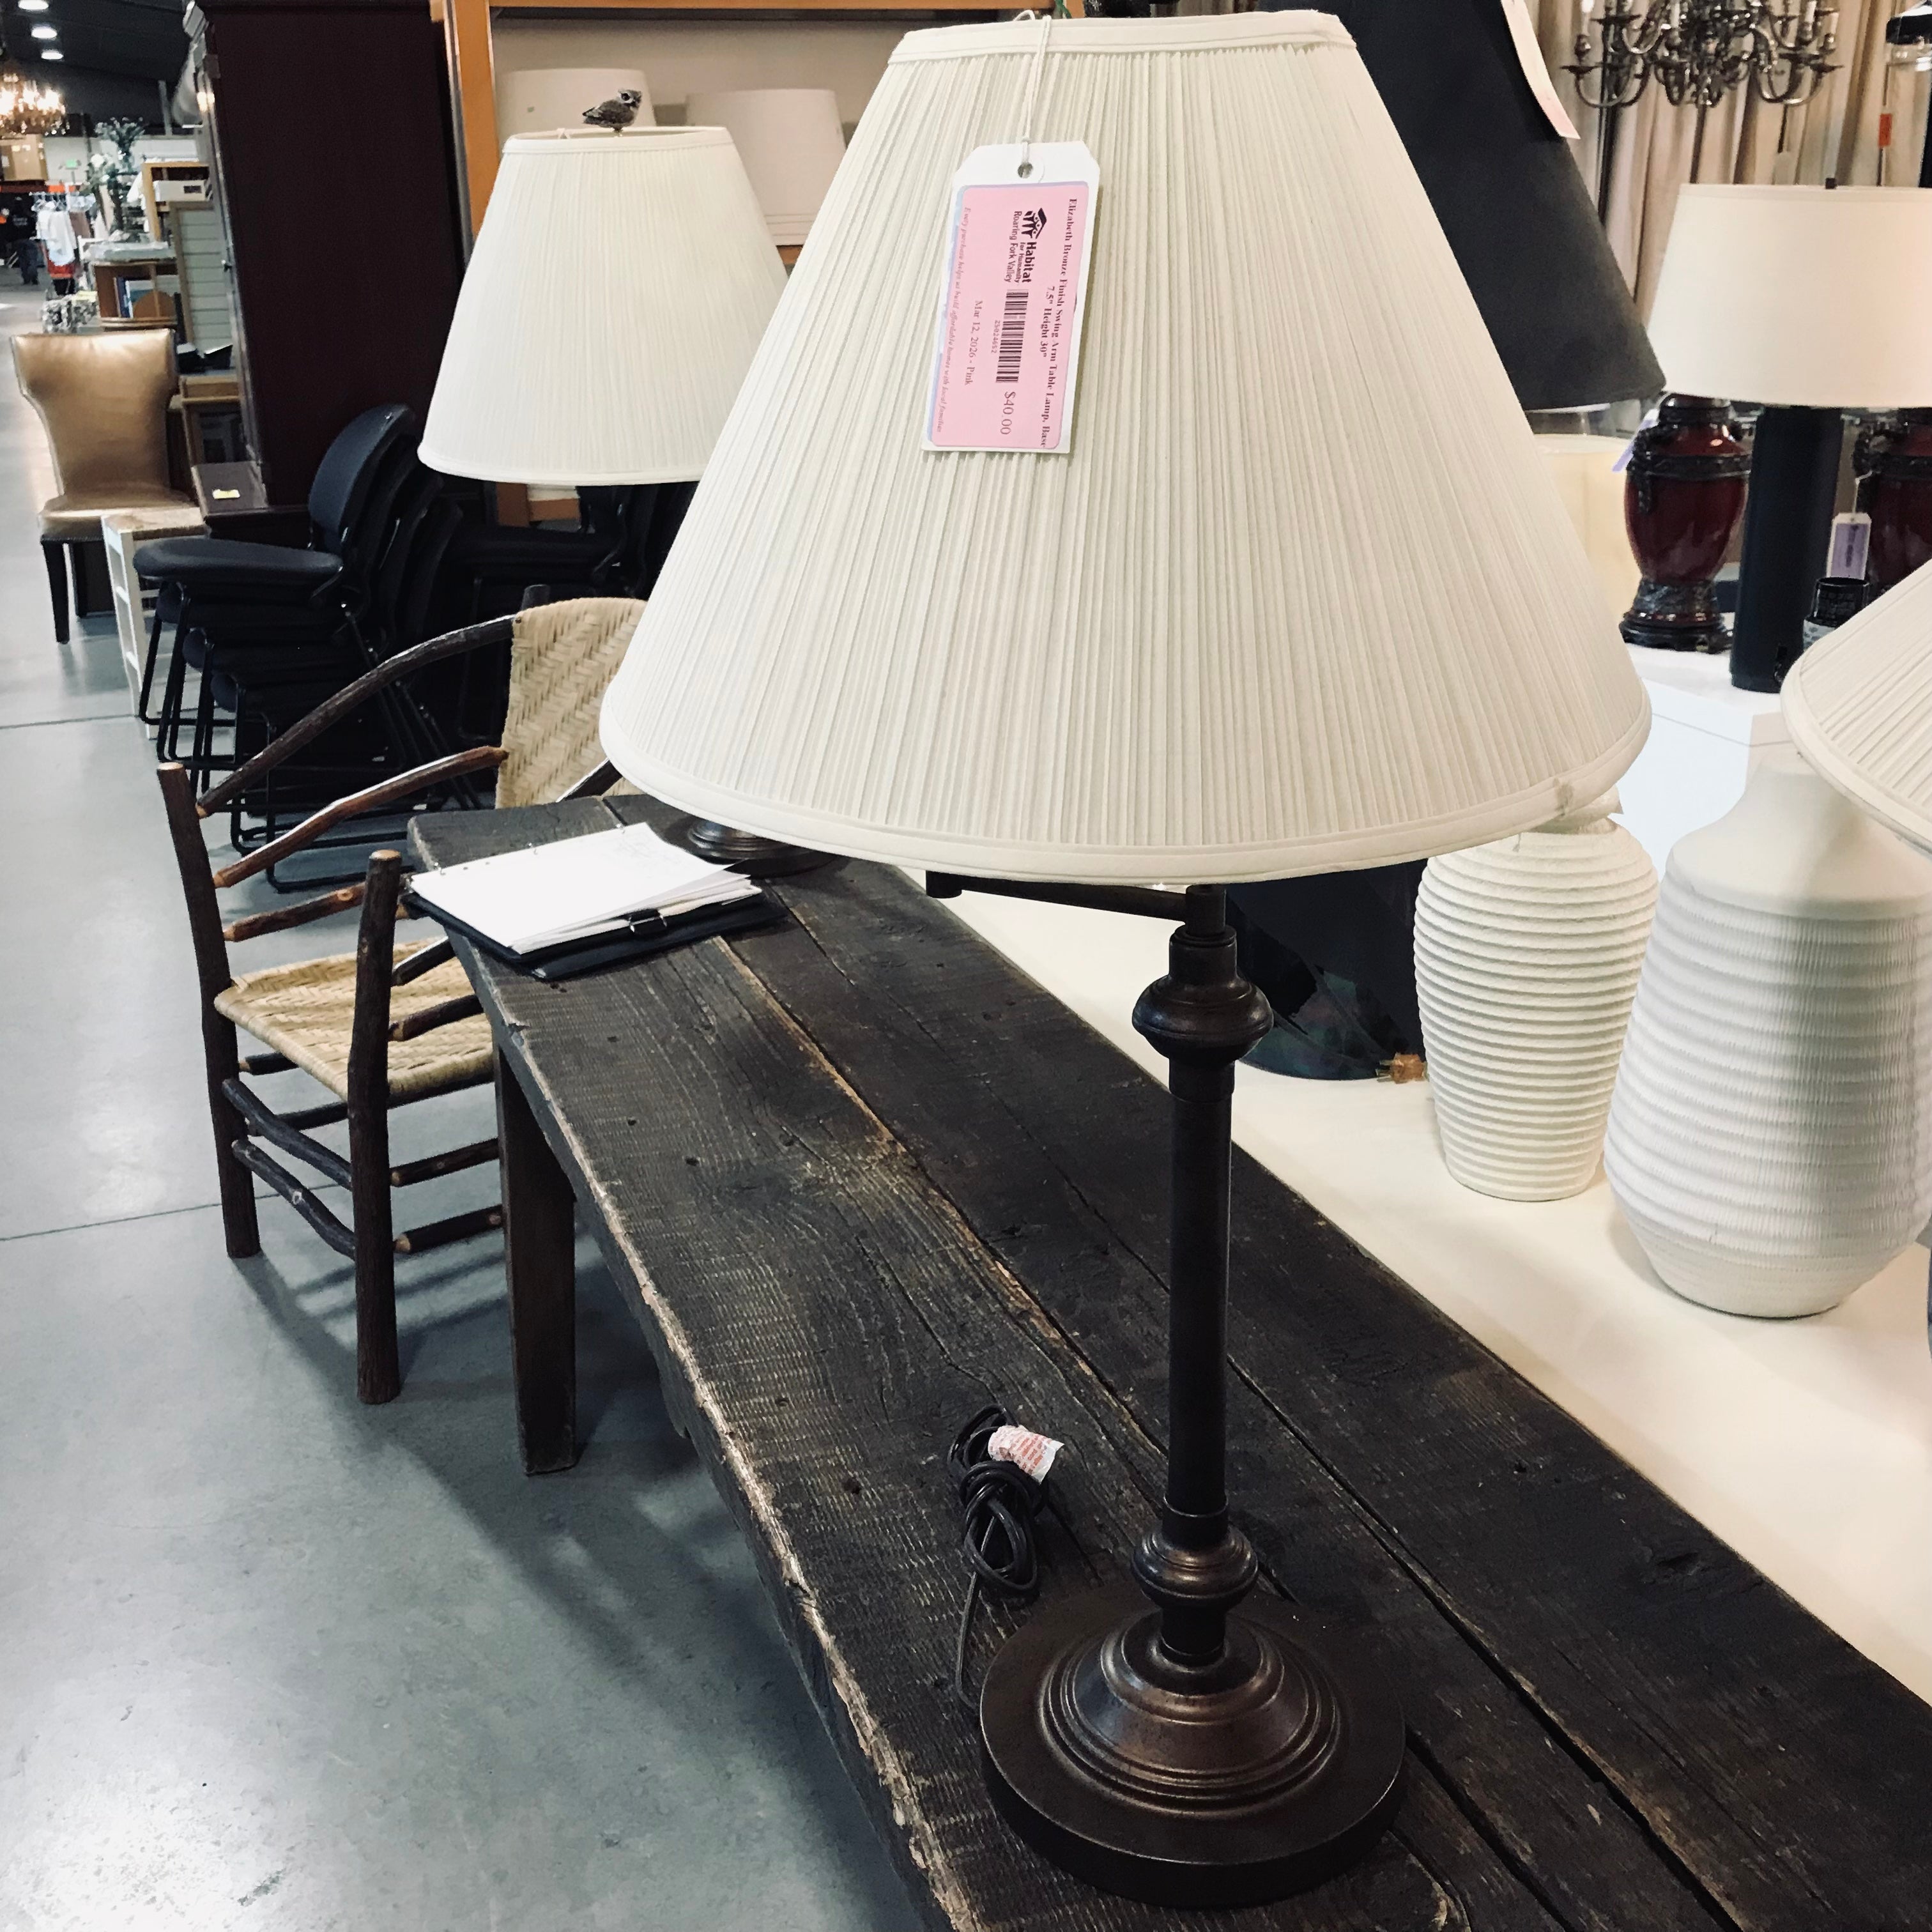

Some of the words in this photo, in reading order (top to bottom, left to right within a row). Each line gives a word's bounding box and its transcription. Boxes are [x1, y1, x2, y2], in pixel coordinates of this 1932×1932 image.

[1009, 211, 1022, 240] Roaring
[1065, 199, 1077, 241] Elizabeth
[1009, 243, 1018, 259] Fork
[1022, 242, 1037, 282] Habitat
[1060, 245, 1071, 275] Bronze
[1004, 261, 1016, 282] Valley
[1014, 253, 1025, 283] Humanity
[1057, 279, 1068, 306] Finish
[974, 300, 983, 319] Mar
[1041, 308, 1052, 338] Height
[1051, 309, 1062, 337] Swing
[969, 337, 979, 358] 2026
[1050, 341, 1059, 362] Arm
[965, 367, 975, 385] Pink
[1048, 365, 1057, 389] Table
[1000, 391, 1016, 434] $40.00
[1041, 393, 1054, 422] Lamp,
